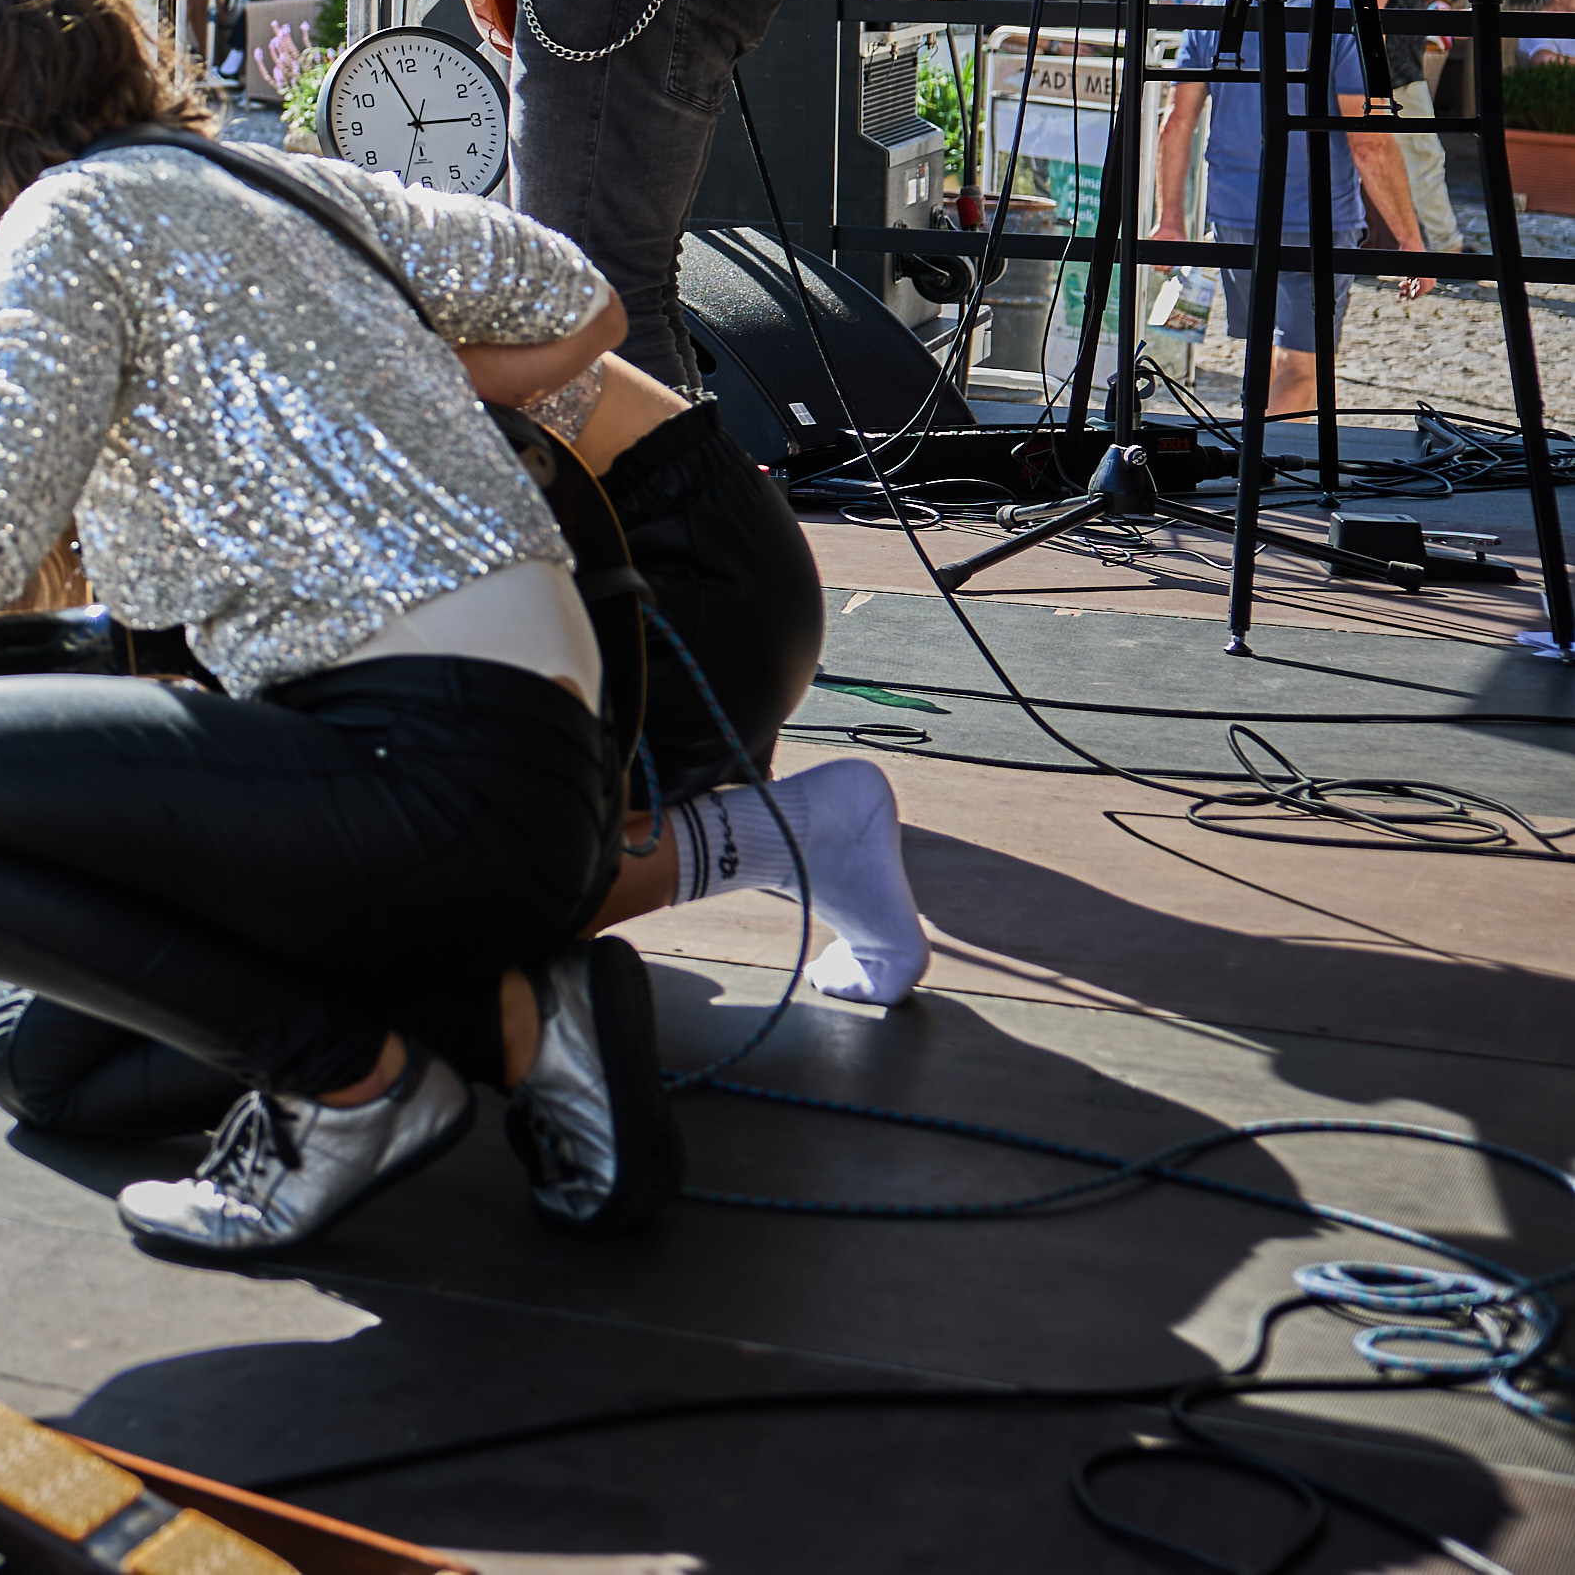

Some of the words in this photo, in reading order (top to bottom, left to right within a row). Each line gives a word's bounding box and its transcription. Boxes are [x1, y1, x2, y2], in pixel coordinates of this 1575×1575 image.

[396, 58, 417, 74] 12
[433, 65, 443, 79] 1
[456, 83, 468, 99] 2
[353, 93, 375, 109] 10
[470, 112, 482, 127] 3
[351, 121, 363, 136] 9
[466, 142, 478, 156] 4
[365, 150, 378, 166] 8
[449, 165, 460, 180] 5
[421, 176, 433, 189] 6
